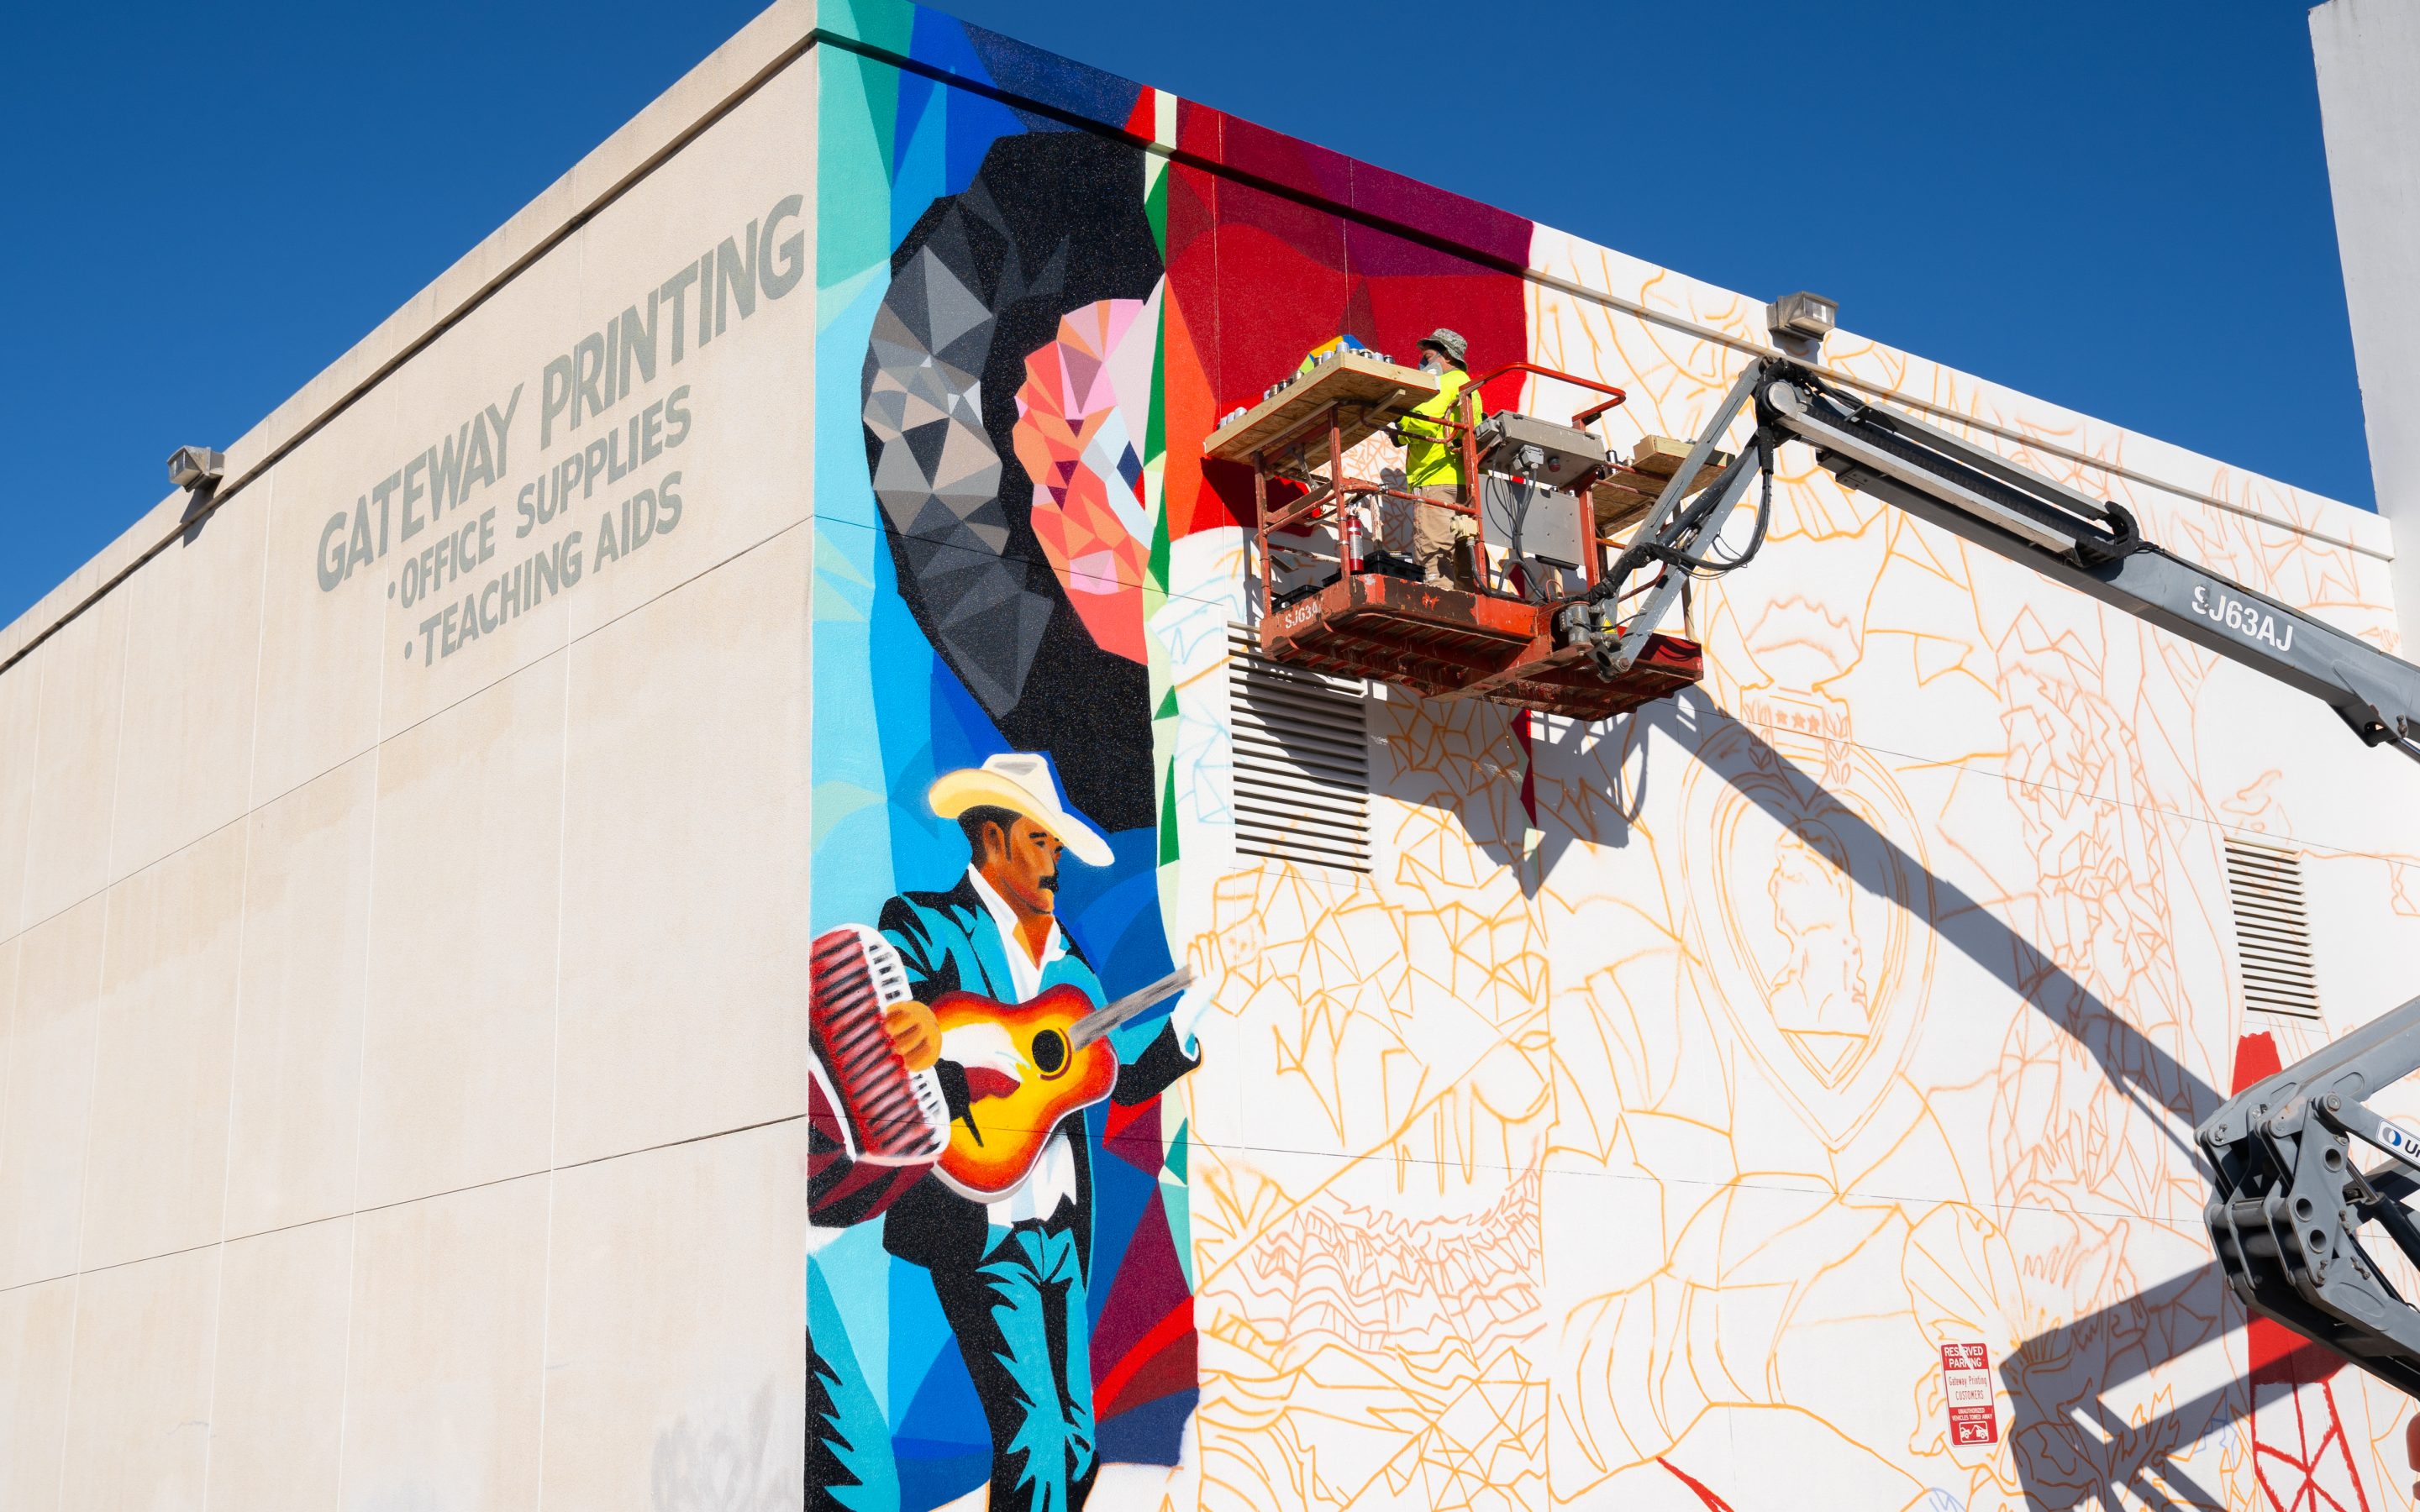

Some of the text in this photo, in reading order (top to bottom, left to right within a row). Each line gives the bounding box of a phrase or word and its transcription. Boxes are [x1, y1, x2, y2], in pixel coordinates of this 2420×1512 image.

[316, 194, 805, 593] GATEWAY PRINTING
[400, 384, 692, 610] OFFICE SUPPLIES
[418, 470, 683, 668] TEACHING AIDS
[1285, 598, 1323, 629] SJ63A
[2191, 585, 2294, 652] SJ63AJ
[1944, 1346, 1984, 1357] RESRVED
[1949, 1357, 1982, 1368] PARNG
[1949, 1375, 1987, 1389] Gateway Printing
[1955, 1390, 1984, 1400] CUSTOMERS
